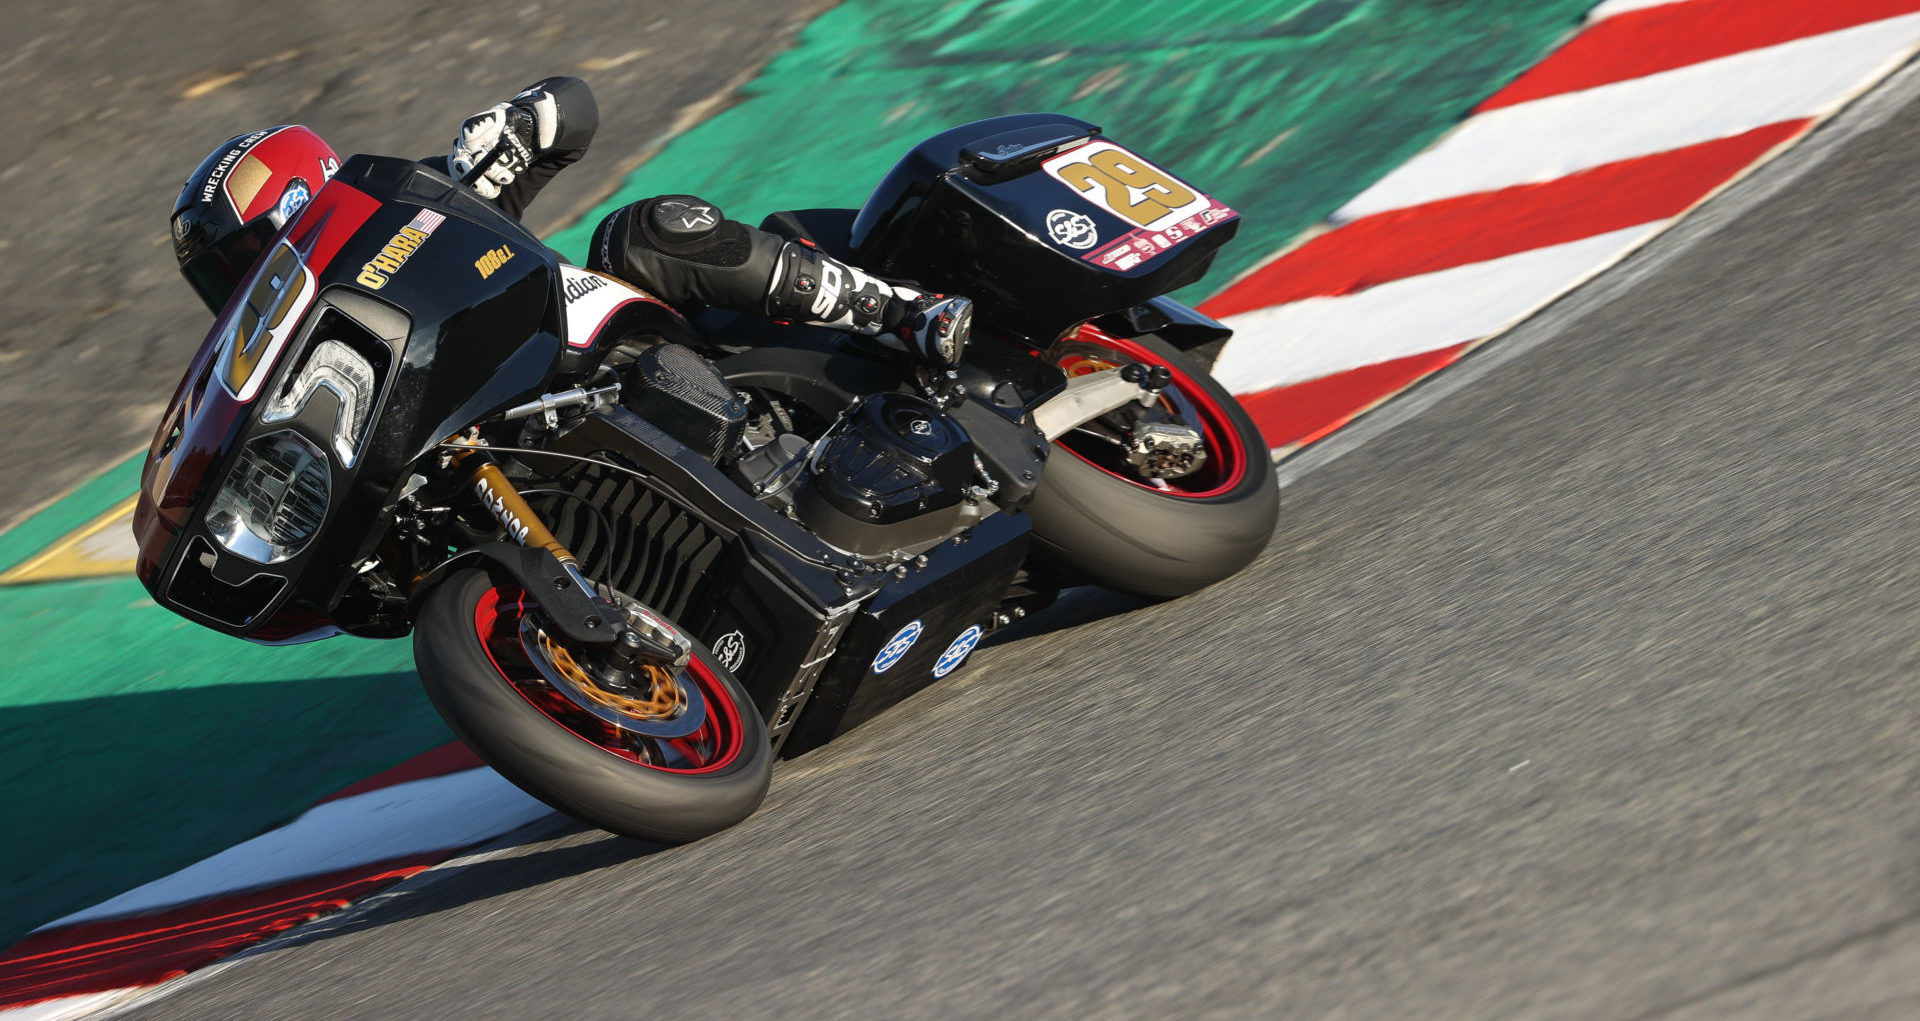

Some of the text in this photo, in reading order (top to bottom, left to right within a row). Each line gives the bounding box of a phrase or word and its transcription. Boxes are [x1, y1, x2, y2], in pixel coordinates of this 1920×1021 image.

[201, 130, 268, 203] WRECKING CREW
[1056, 148, 1197, 227] 29
[356, 225, 429, 291] O'HARA
[222, 243, 306, 397] 29
